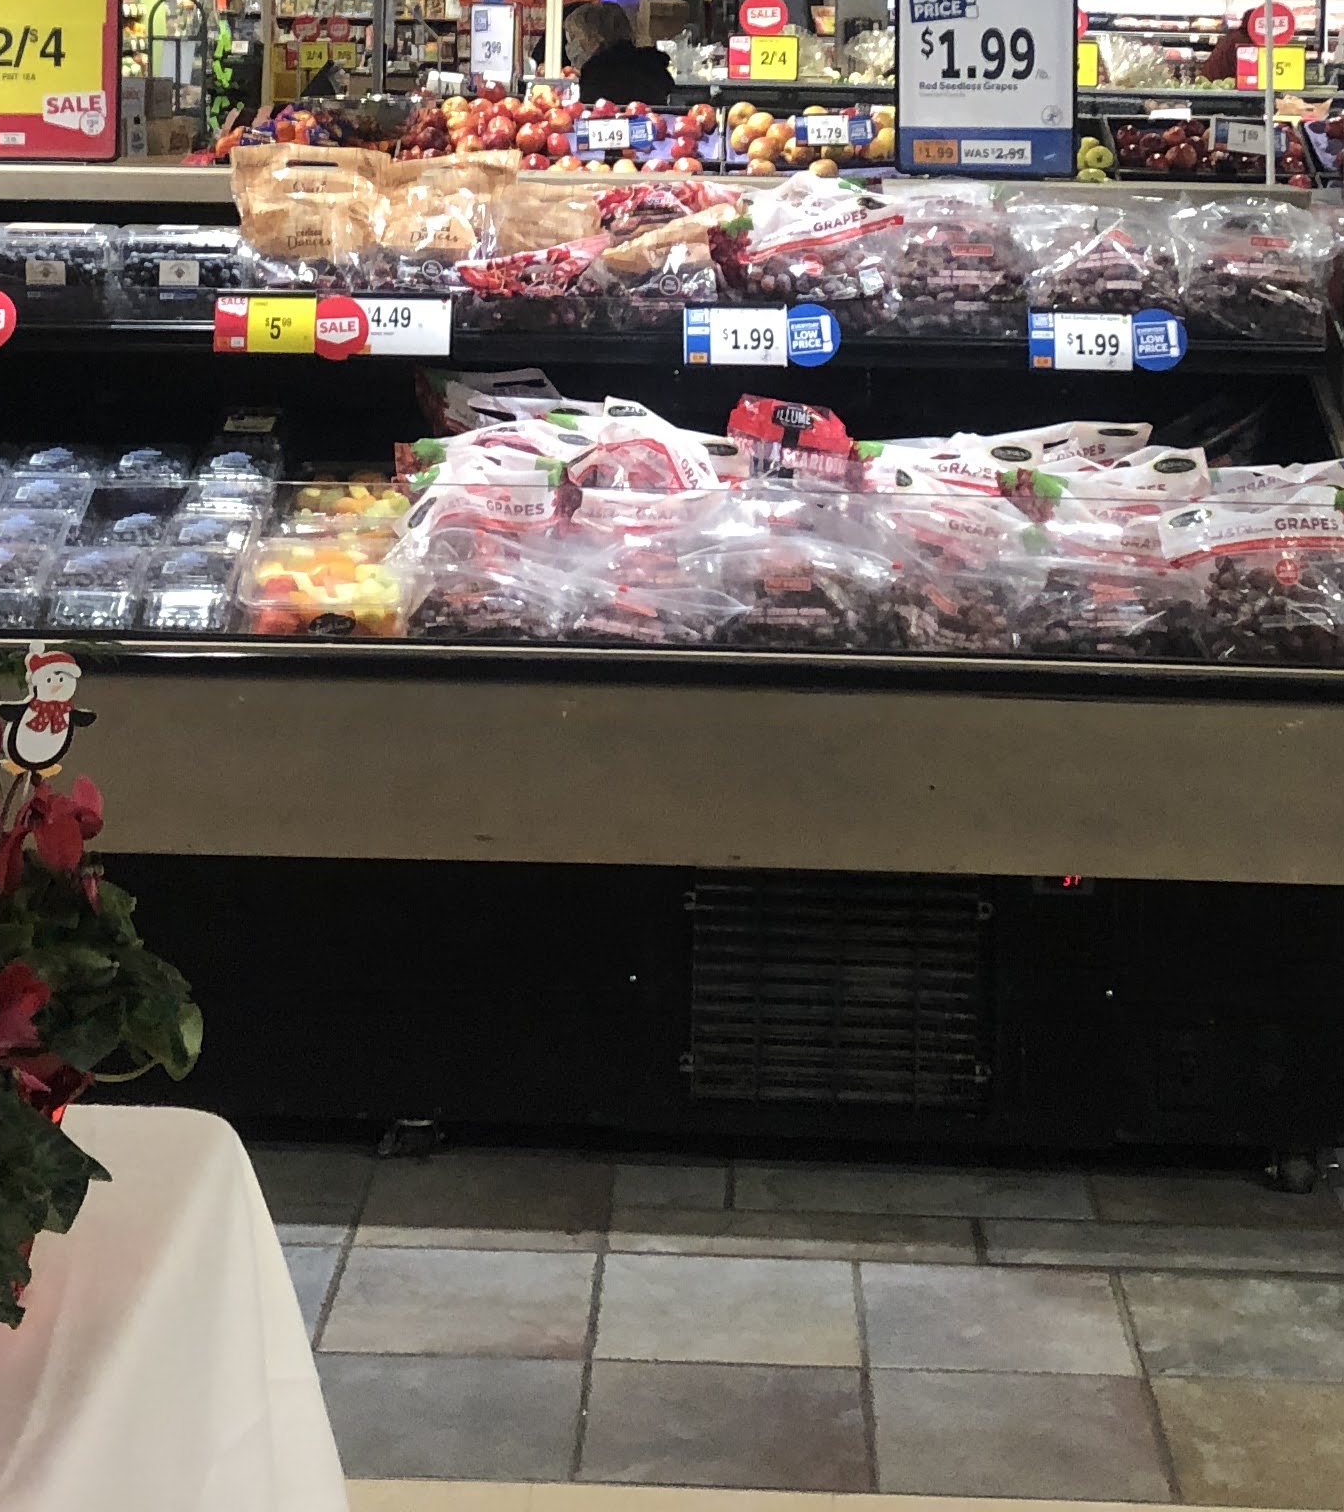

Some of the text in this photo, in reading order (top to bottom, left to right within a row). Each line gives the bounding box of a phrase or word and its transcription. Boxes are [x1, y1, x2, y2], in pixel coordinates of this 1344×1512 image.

[750, 9, 779, 19] SALE
[1257, 18, 1286, 29] SLE
[920, 25, 1035, 80] $1.99
[918, 81, 1019, 93] Red Seedless Grapes
[46, 94, 103, 115] SALE
[963, 149, 990, 160] WAS
[813, 207, 868, 233] GRAPES
[368, 305, 412, 329] $4.49
[319, 320, 357, 335] SALE
[793, 330, 818, 340] LOW
[722, 327, 774, 350] $1.99
[792, 339, 822, 350] PRICE
[1066, 332, 1120, 357] $1.99
[1139, 334, 1165, 344] LOW
[1138, 343, 1169, 354] PRICE
[775, 407, 812, 426] ILLUME
[485, 498, 546, 517] GRAPES
[1274, 517, 1340, 532] GRAPES
